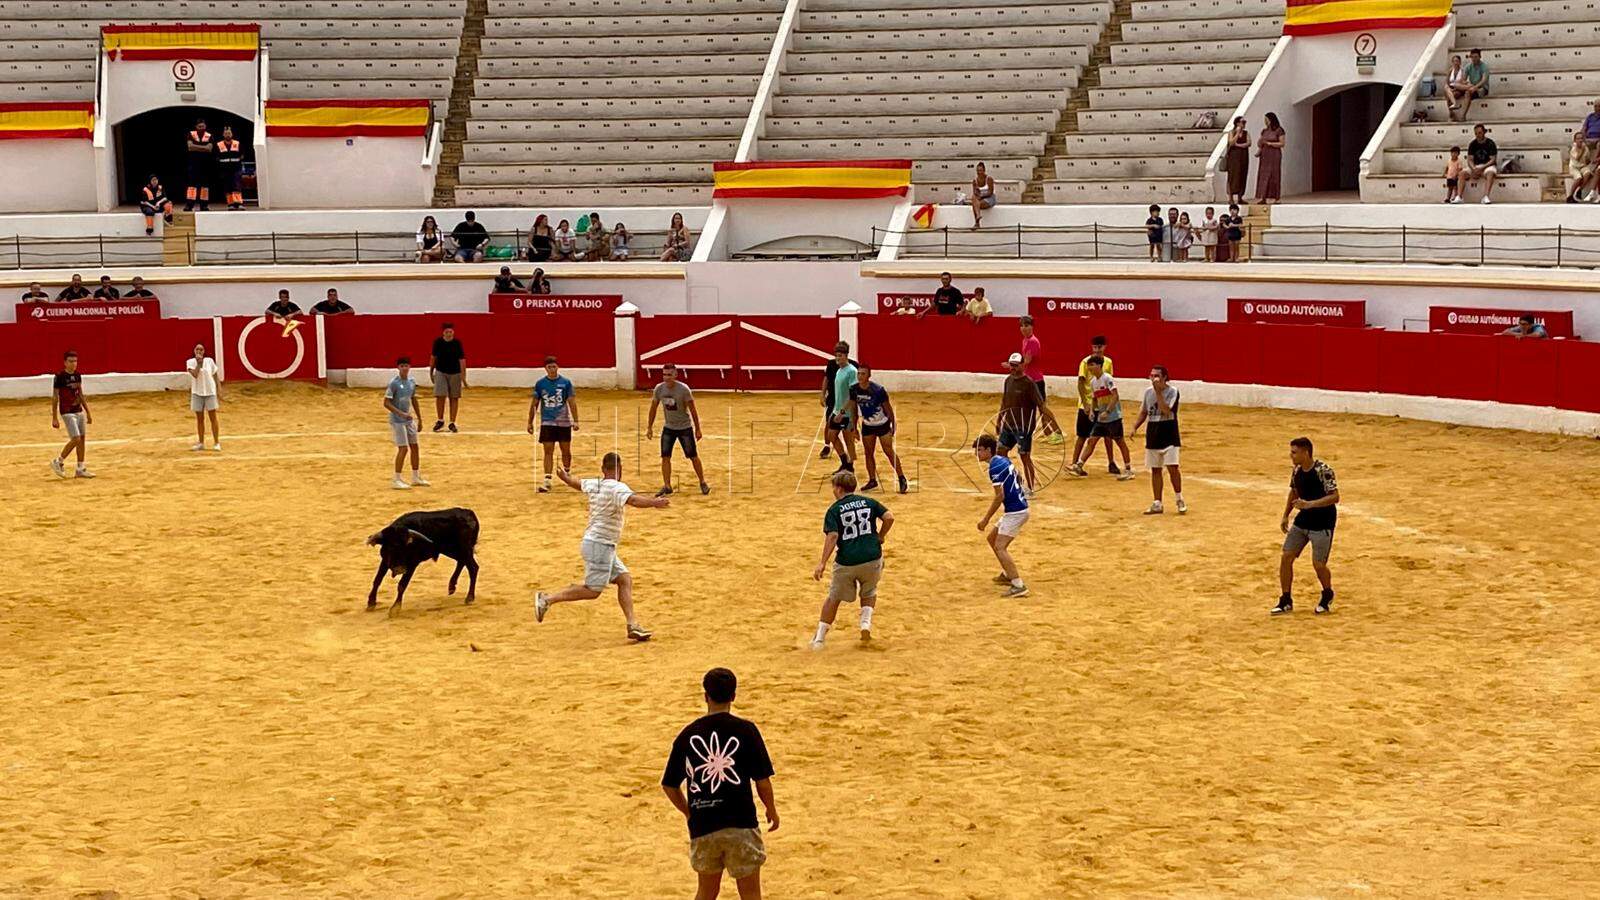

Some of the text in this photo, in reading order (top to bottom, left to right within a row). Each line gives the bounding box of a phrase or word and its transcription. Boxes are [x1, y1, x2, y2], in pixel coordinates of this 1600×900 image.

[526, 299, 562, 308] PRENSA
[563, 299, 570, 308] Y
[572, 299, 602, 308] RADIO
[896, 298, 931, 307] PNSA
[1060, 302, 1095, 310] PRENSA
[1097, 302, 1104, 310] Y
[1106, 303, 1135, 311] RADIO
[46, 307, 73, 316] CUERPO
[74, 307, 107, 316] NACIONAL
[108, 306, 118, 315] DE
[118, 305, 145, 315] POLICÍA
[1256, 304, 1290, 314] CIUDAD
[1291, 304, 1344, 316] AUTÓNOMA
[1458, 314, 1479, 324] CIUDAD
[1480, 313, 1511, 325] AUTÓNOMA
[840, 500, 868, 512] JORGE
[840, 508, 872, 540] 88
